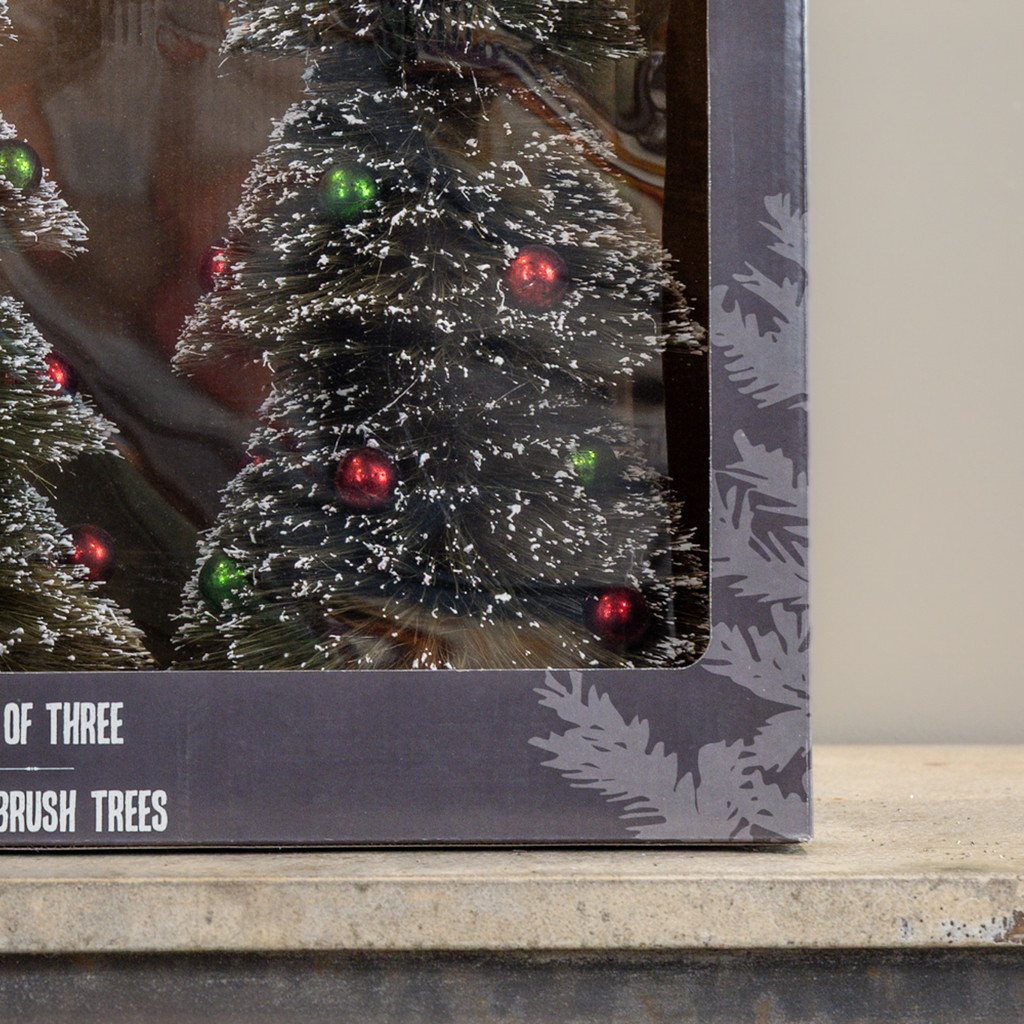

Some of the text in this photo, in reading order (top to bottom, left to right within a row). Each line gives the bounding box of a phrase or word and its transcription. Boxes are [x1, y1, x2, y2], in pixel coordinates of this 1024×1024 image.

[3, 702, 34, 745] OF
[45, 701, 124, 745] THREE
[90, 789, 168, 833] TREES
